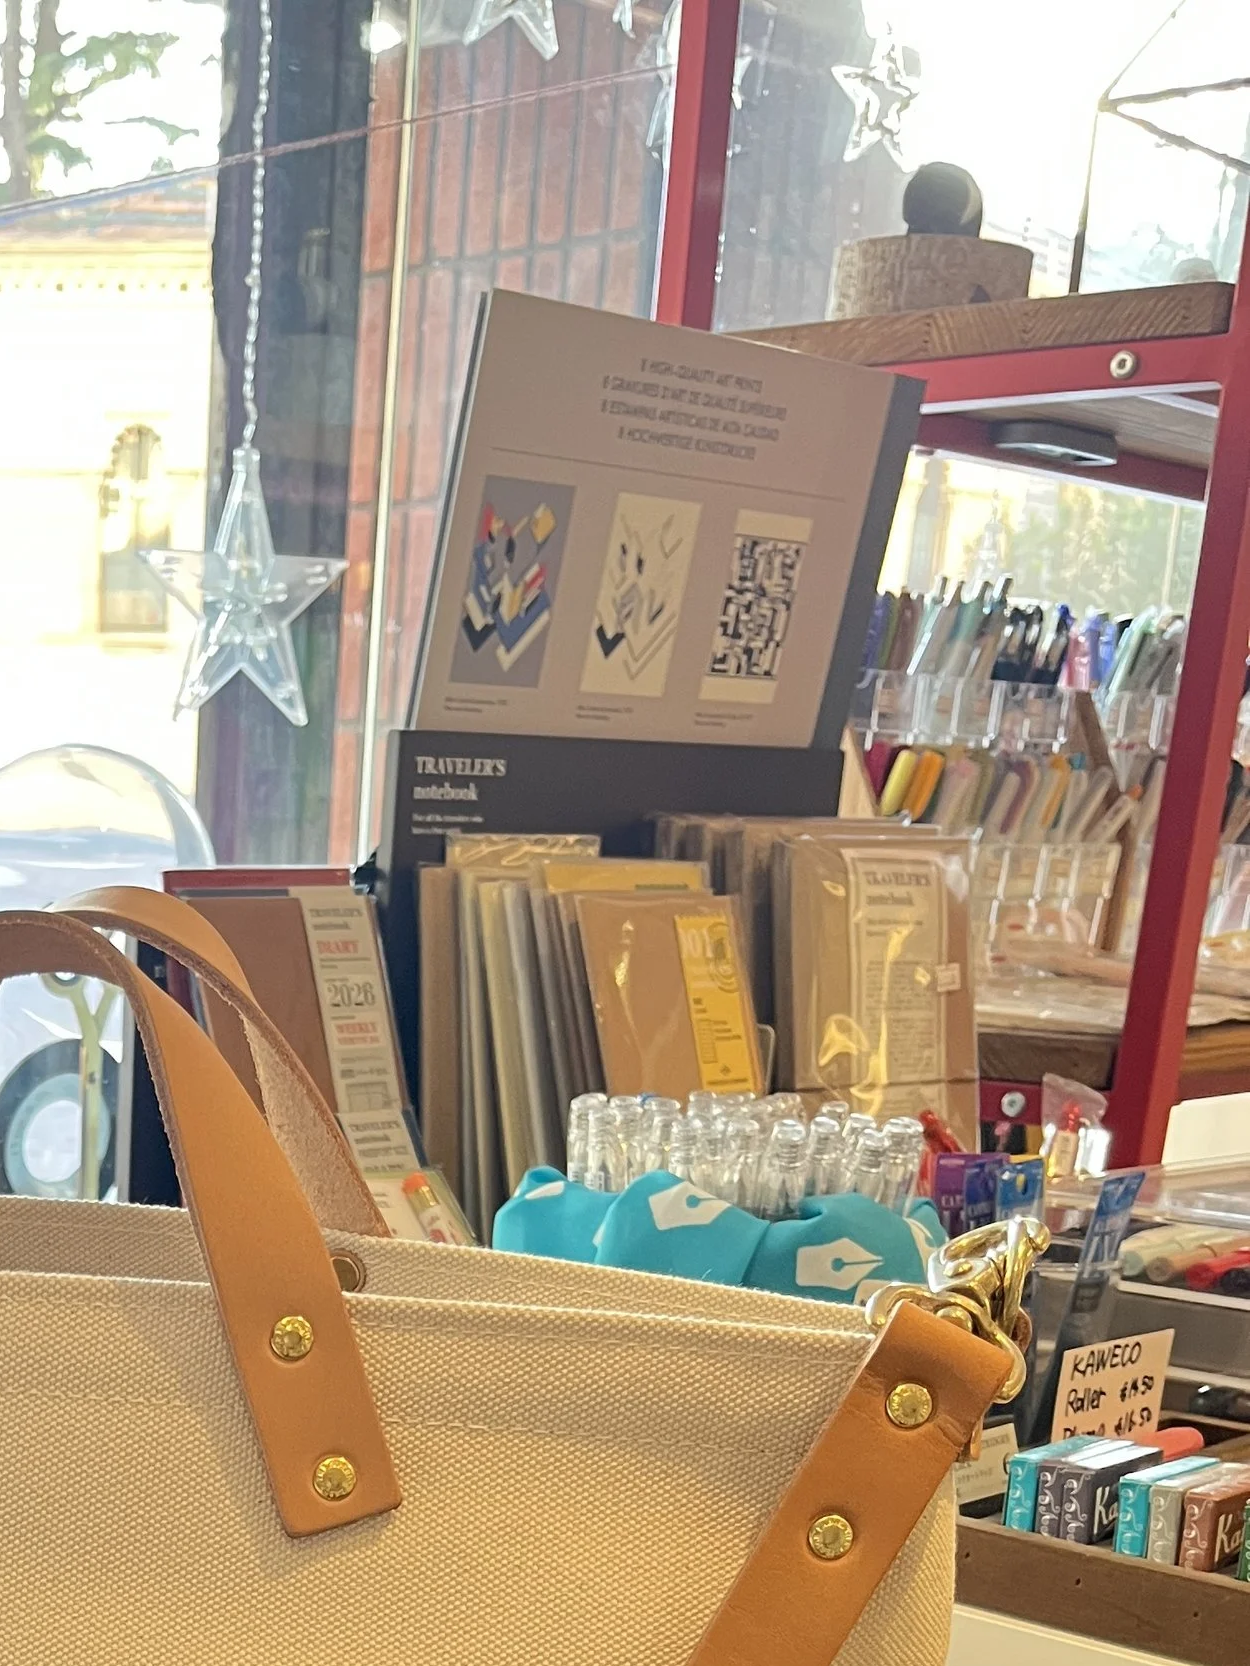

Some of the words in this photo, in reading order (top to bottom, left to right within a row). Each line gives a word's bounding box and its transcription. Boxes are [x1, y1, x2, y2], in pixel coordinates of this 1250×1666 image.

[414, 756, 507, 777] TRAVELER'S
[413, 781, 479, 801] notebook
[327, 982, 376, 1008] 2026
[1070, 1341, 1143, 1381] KAWECO
[1065, 1387, 1107, 1417] Roller
